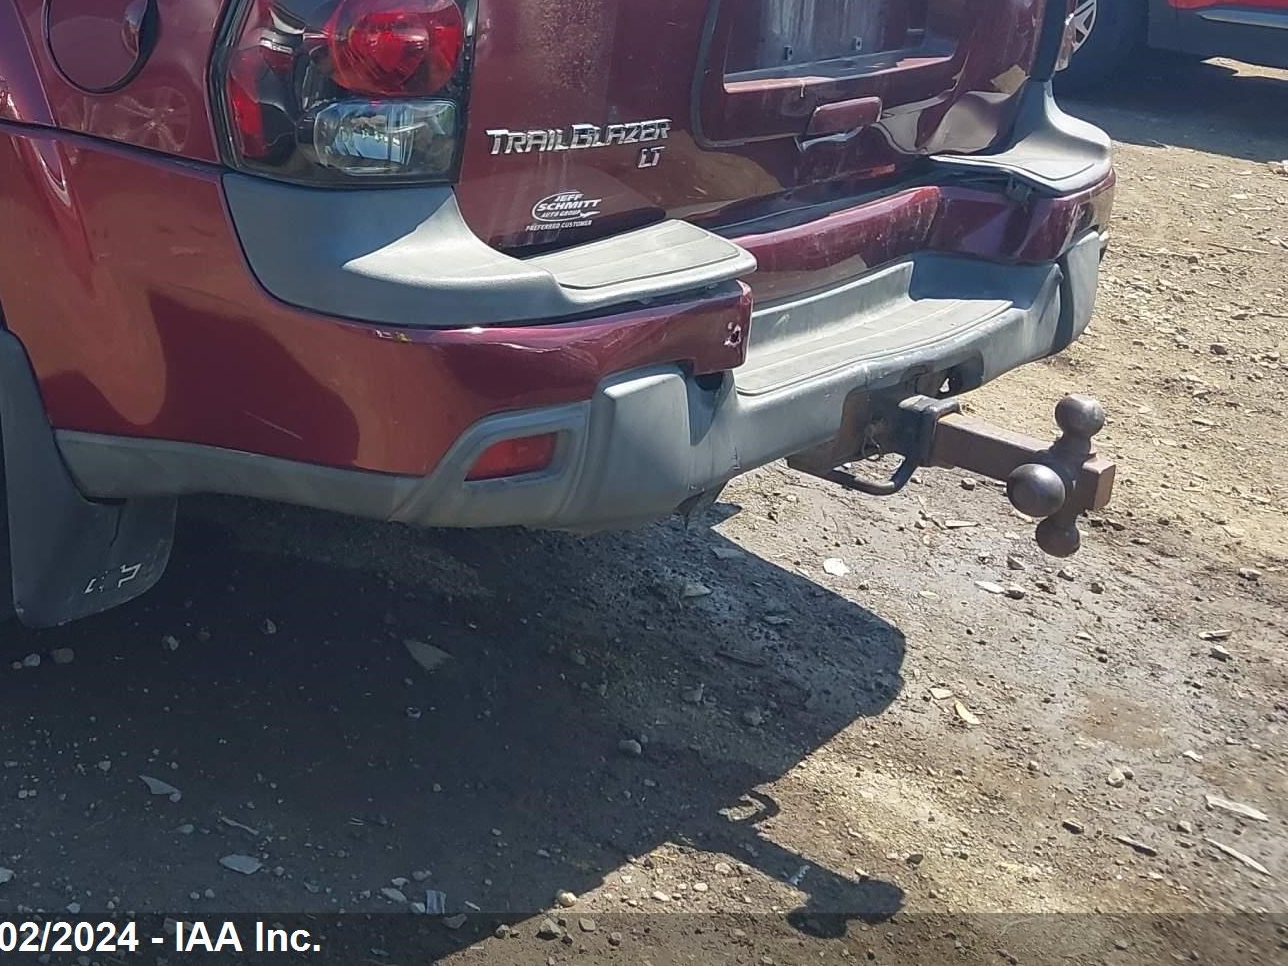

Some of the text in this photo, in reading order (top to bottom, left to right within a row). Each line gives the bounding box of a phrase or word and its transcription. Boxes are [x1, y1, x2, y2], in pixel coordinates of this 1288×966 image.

[638, 147, 665, 169] LT
[554, 193, 584, 203] JEFF
[536, 199, 602, 212] SCHMITT
